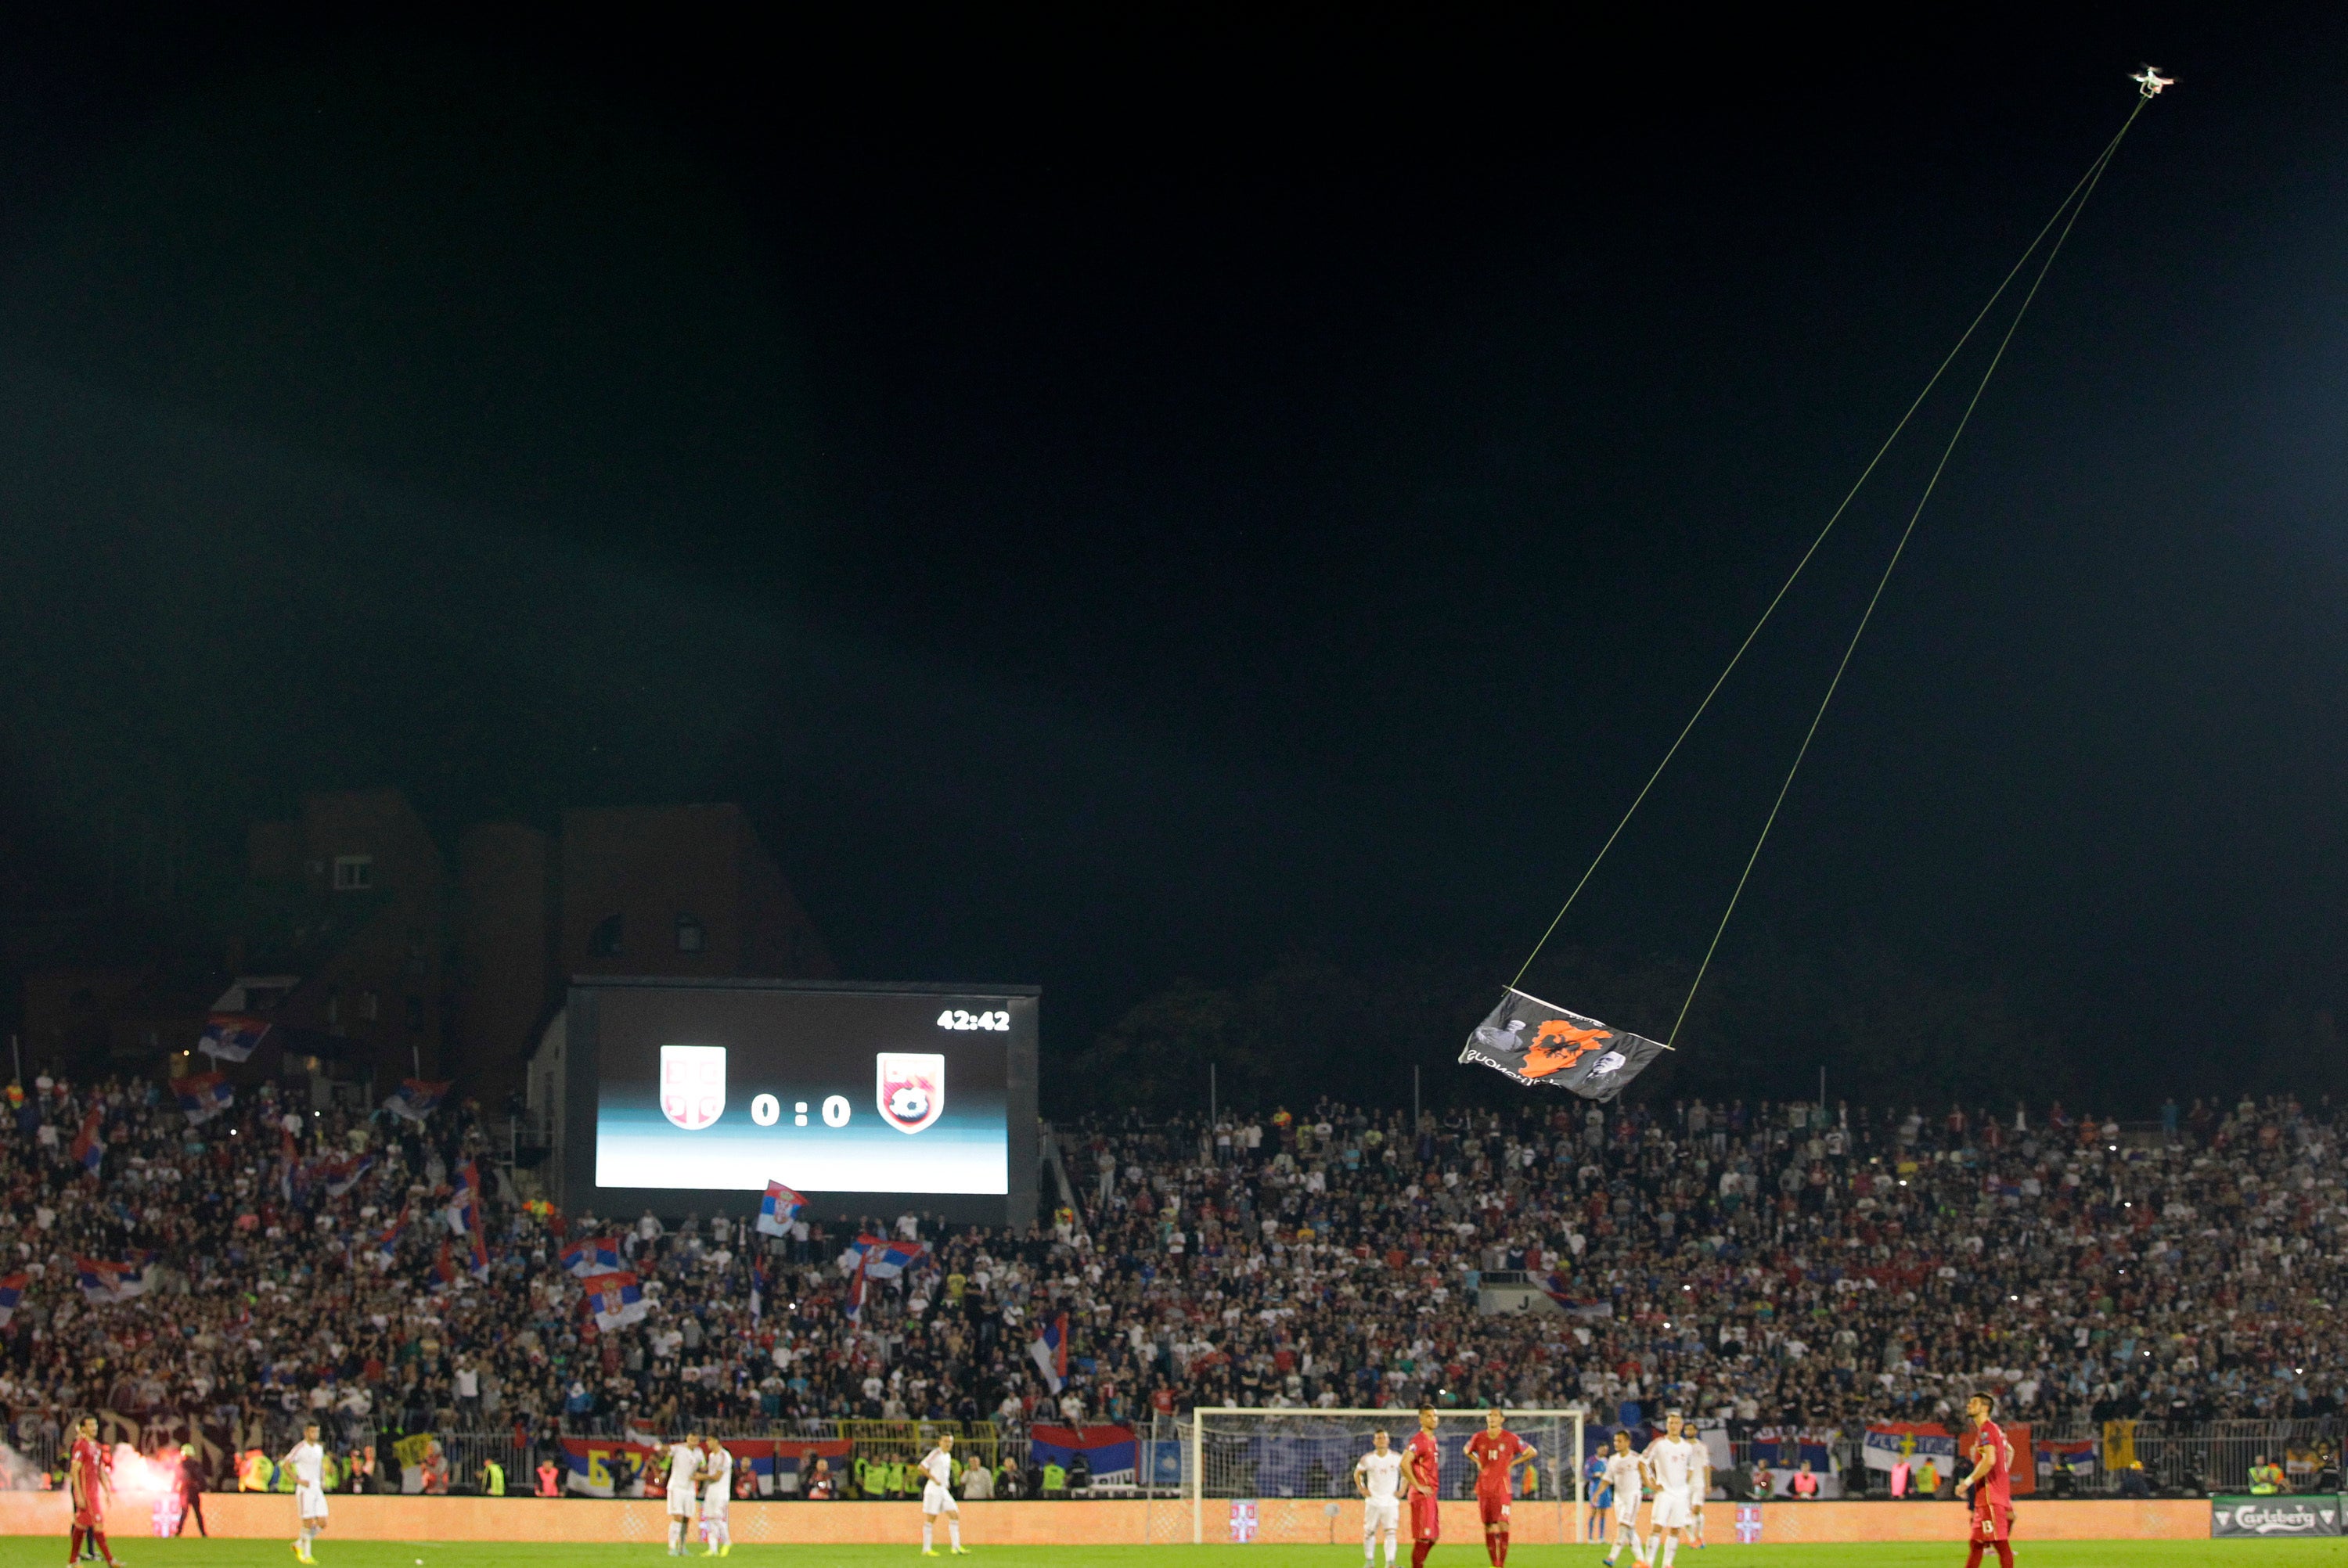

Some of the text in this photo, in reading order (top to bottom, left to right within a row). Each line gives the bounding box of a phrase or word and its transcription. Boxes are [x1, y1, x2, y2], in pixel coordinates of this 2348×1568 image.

[937, 1010, 1010, 1031] 42:42
[751, 1093, 780, 1127] 0
[822, 1095, 851, 1127] 0
[1518, 1295, 1529, 1311] J
[2235, 1505, 2316, 1534] Carlsberg
